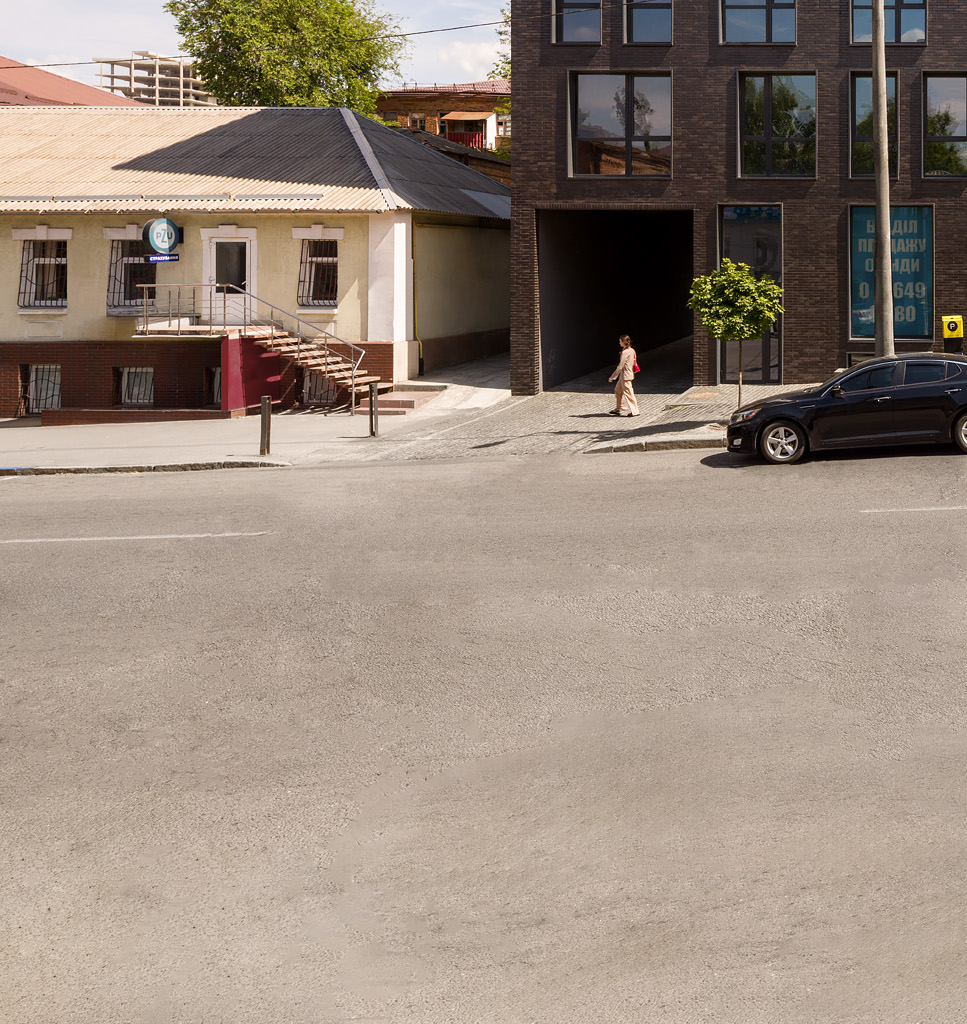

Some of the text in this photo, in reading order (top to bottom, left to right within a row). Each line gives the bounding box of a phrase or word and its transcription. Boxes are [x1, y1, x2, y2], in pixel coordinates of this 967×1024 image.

[866, 220, 918, 235] ВДІЛ
[156, 229, 173, 243] PZU
[865, 258, 919, 274] ОНДИ
[893, 281, 926, 299] 649
